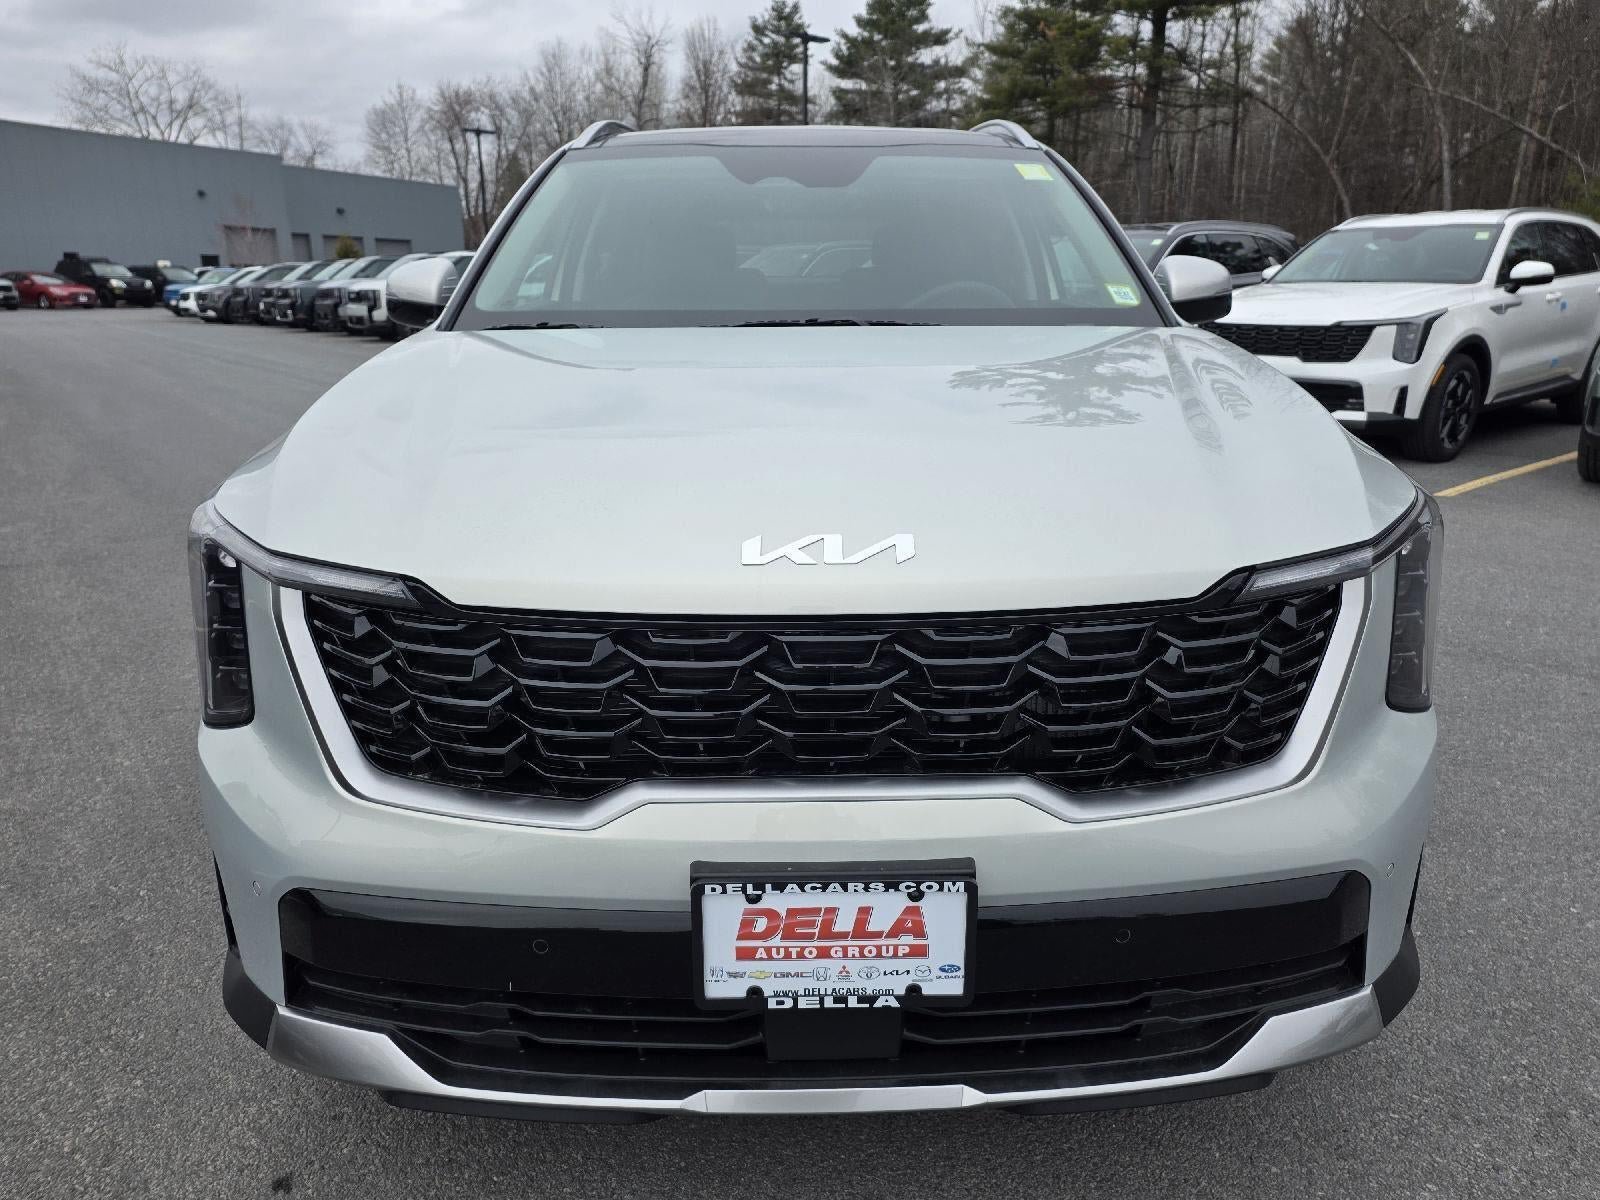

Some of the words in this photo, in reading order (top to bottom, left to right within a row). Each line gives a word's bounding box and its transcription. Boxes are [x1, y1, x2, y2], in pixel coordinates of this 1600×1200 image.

[704, 882, 965, 895] DELLACARS.COM
[736, 906, 928, 942] DELLA
[754, 947, 818, 959] AUTO
[830, 946, 911, 958] GROUP
[773, 987, 895, 997] www.DELLACARS.com
[768, 995, 901, 1009] DELLA
